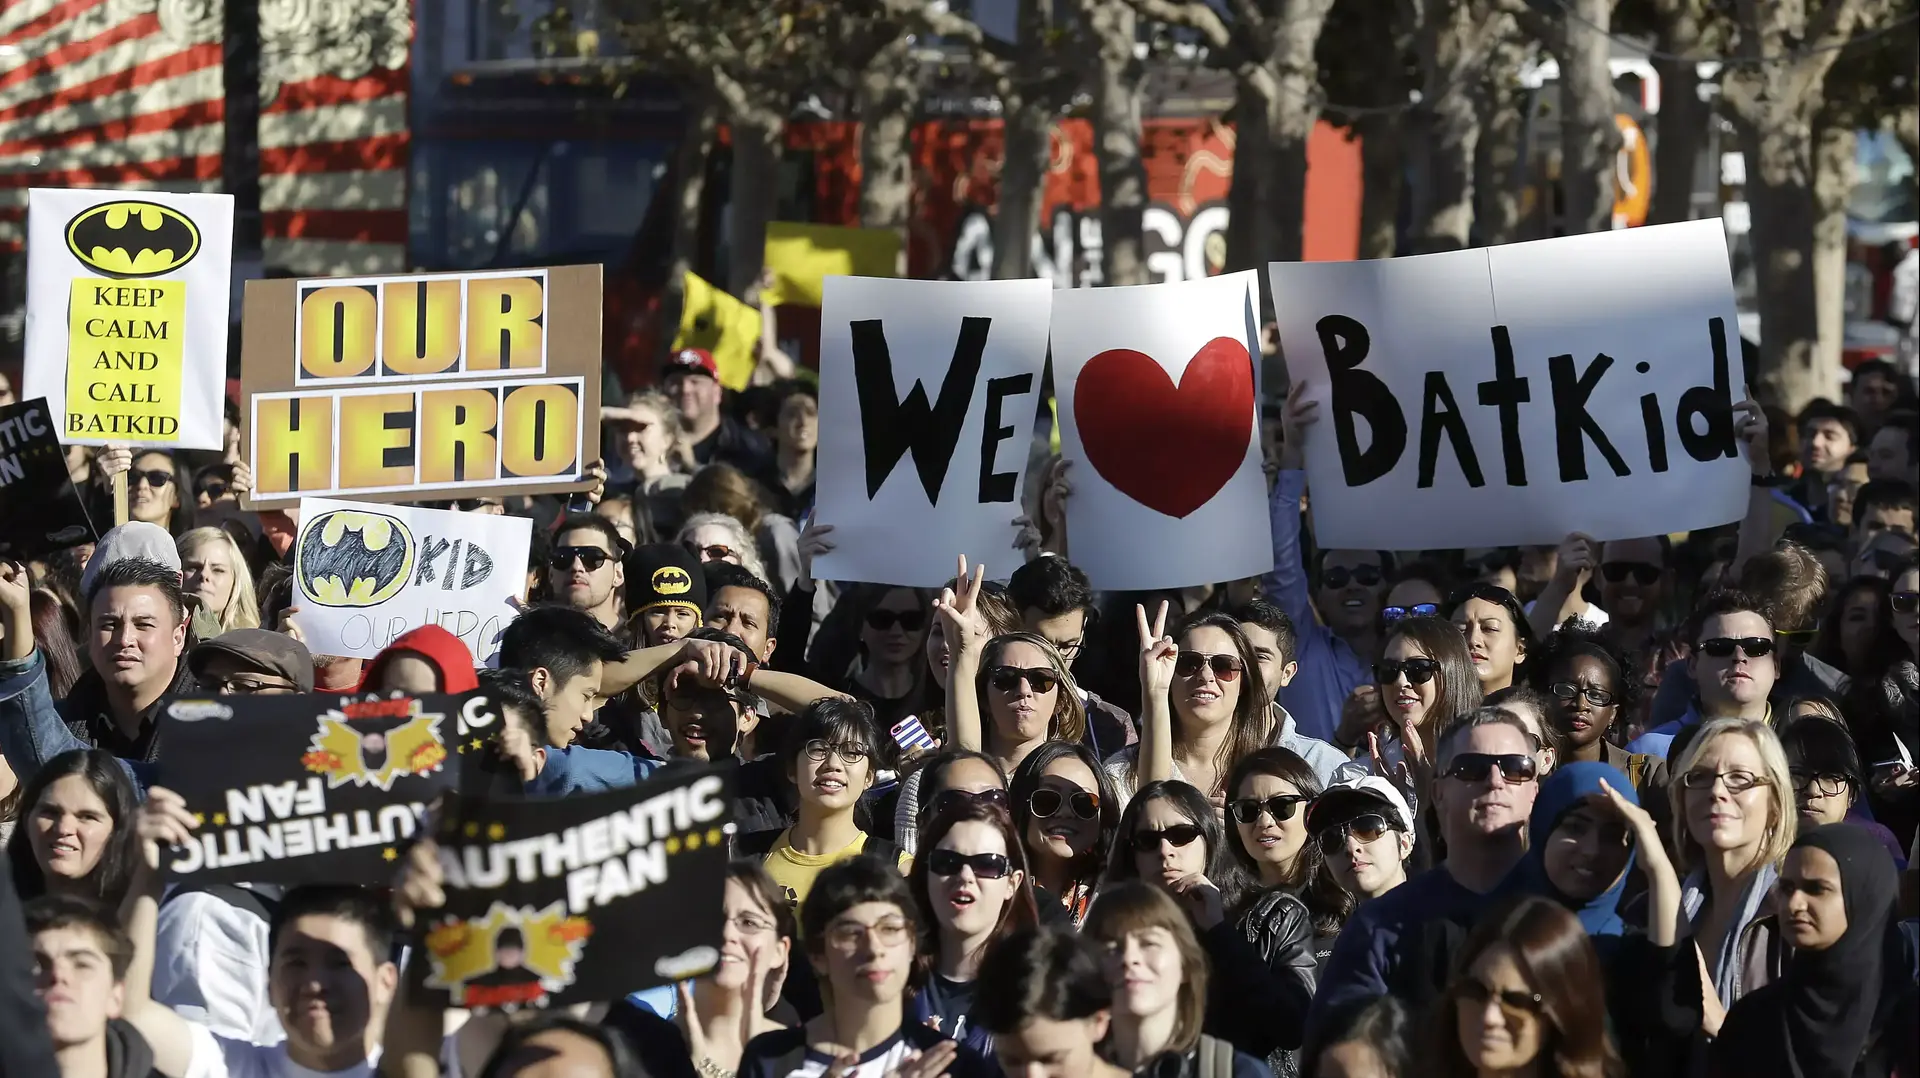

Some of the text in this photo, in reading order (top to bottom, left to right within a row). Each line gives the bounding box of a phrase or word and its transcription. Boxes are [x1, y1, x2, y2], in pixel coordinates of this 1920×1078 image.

[93, 286, 164, 308] KEEP
[85, 318, 170, 340] CALM
[301, 276, 544, 378] OUR
[93, 350, 159, 371] AND
[88, 382, 161, 403] CALL
[68, 413, 179, 435] BATKID
[256, 384, 578, 493] HERO
[414, 534, 494, 591] KID
[340, 613, 408, 651] OUR
[226, 776, 326, 825] FAN
[438, 775, 725, 889] AUTHENTIC
[567, 841, 668, 914] FAN
